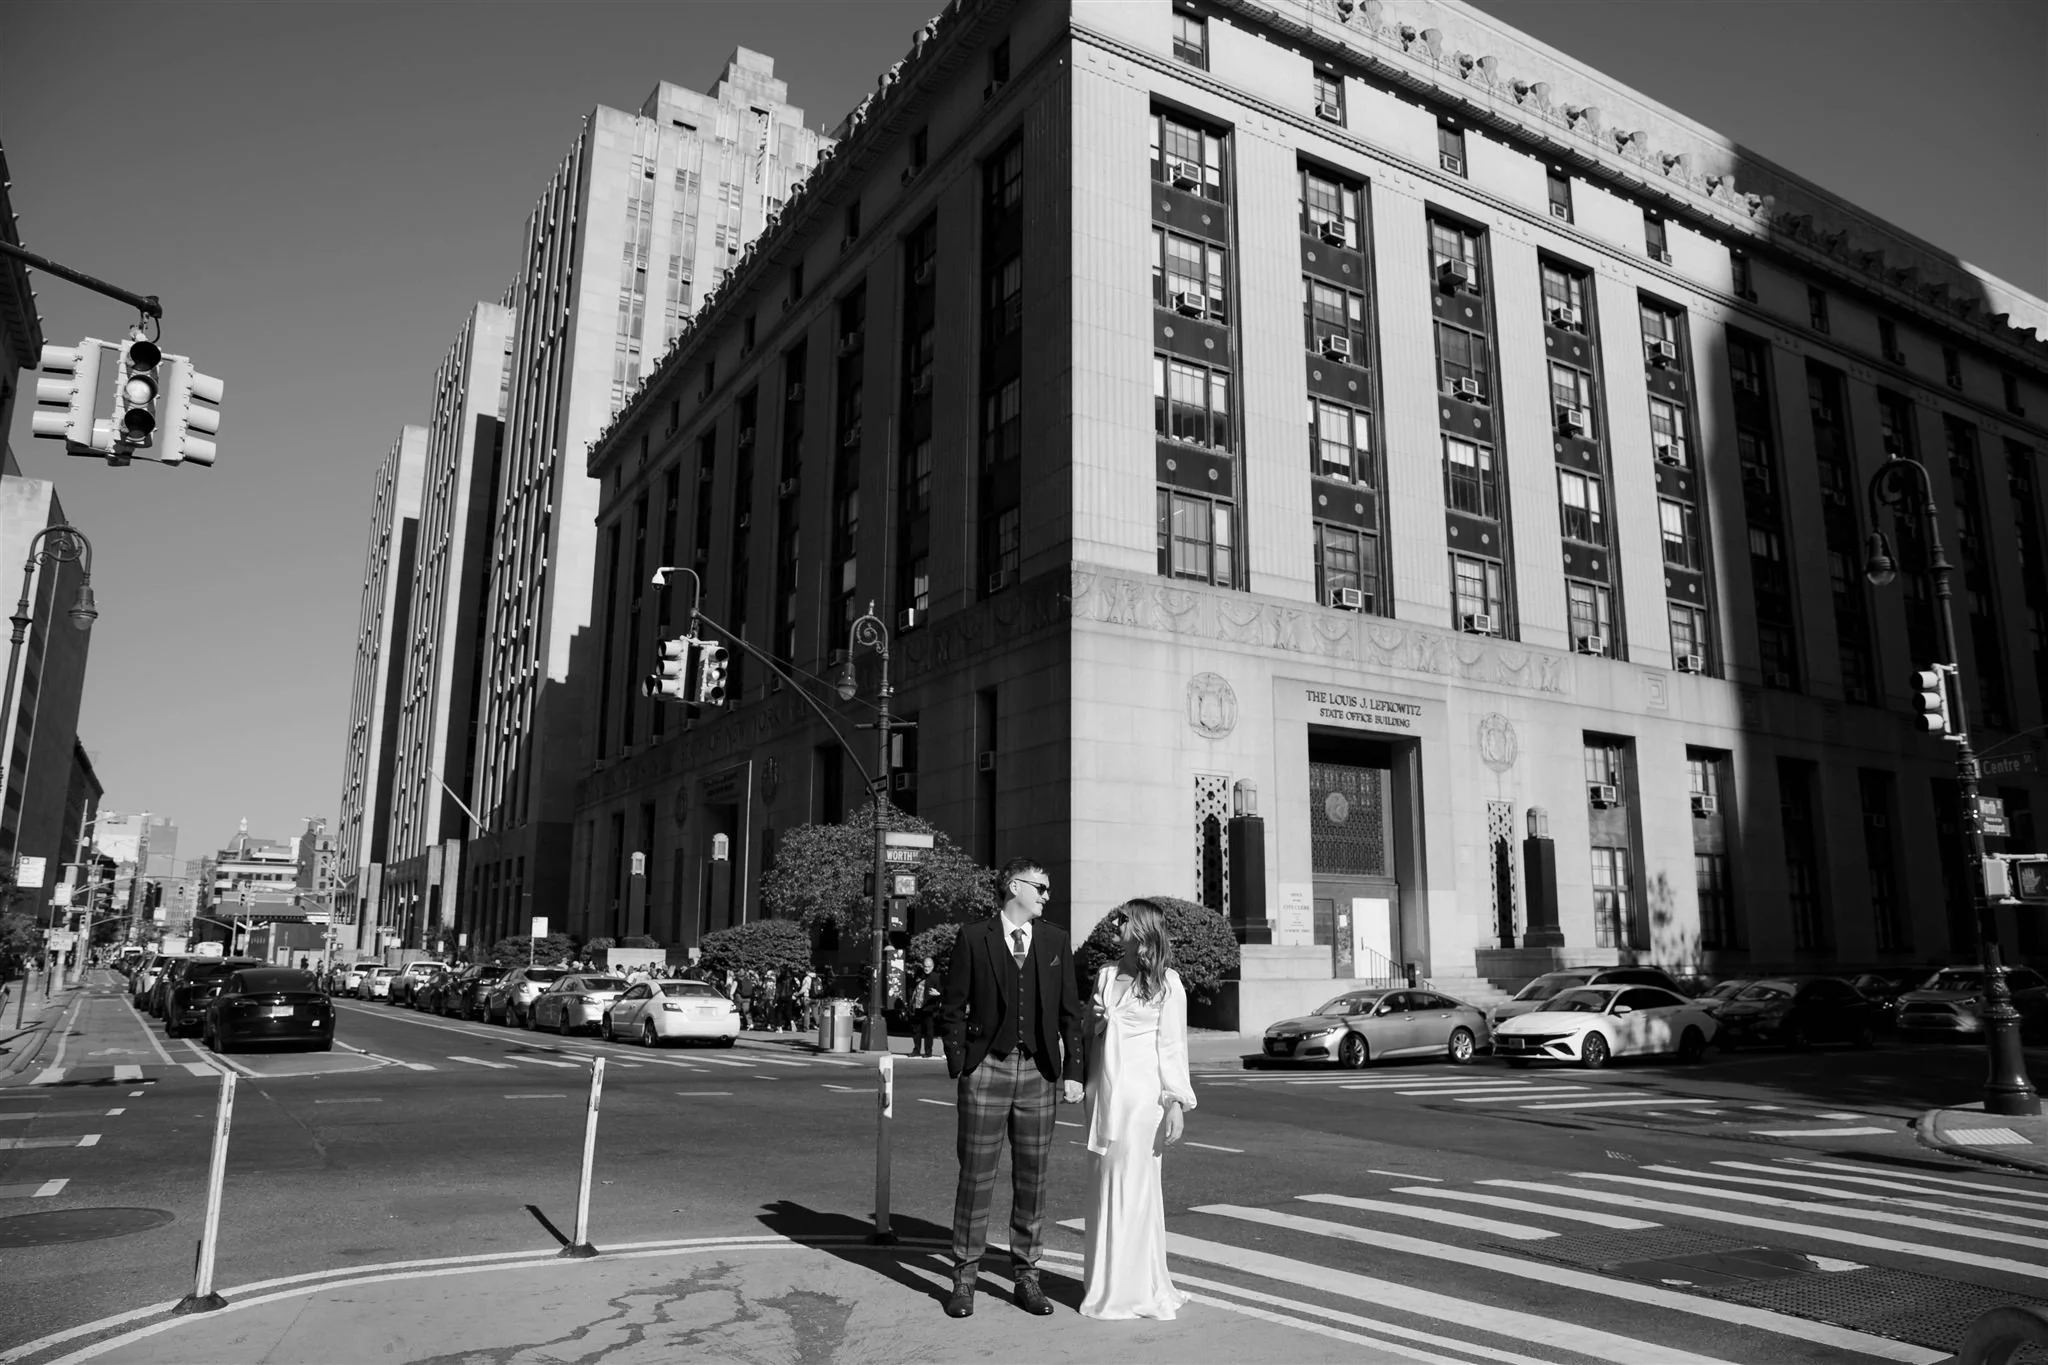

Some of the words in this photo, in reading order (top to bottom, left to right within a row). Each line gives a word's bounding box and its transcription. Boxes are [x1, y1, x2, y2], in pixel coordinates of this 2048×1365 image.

[1306, 690, 1326, 703] THE
[1329, 693, 1357, 707] LOUIS
[1360, 697, 1368, 709] J.
[1370, 699, 1421, 716] LEFKOWITZ
[1320, 708, 1344, 719] STATE
[1345, 711, 1372, 723] OFFICE
[1374, 715, 1410, 728] BUILDING
[1983, 759, 2019, 774] Centre
[887, 850, 912, 860] WORTH
